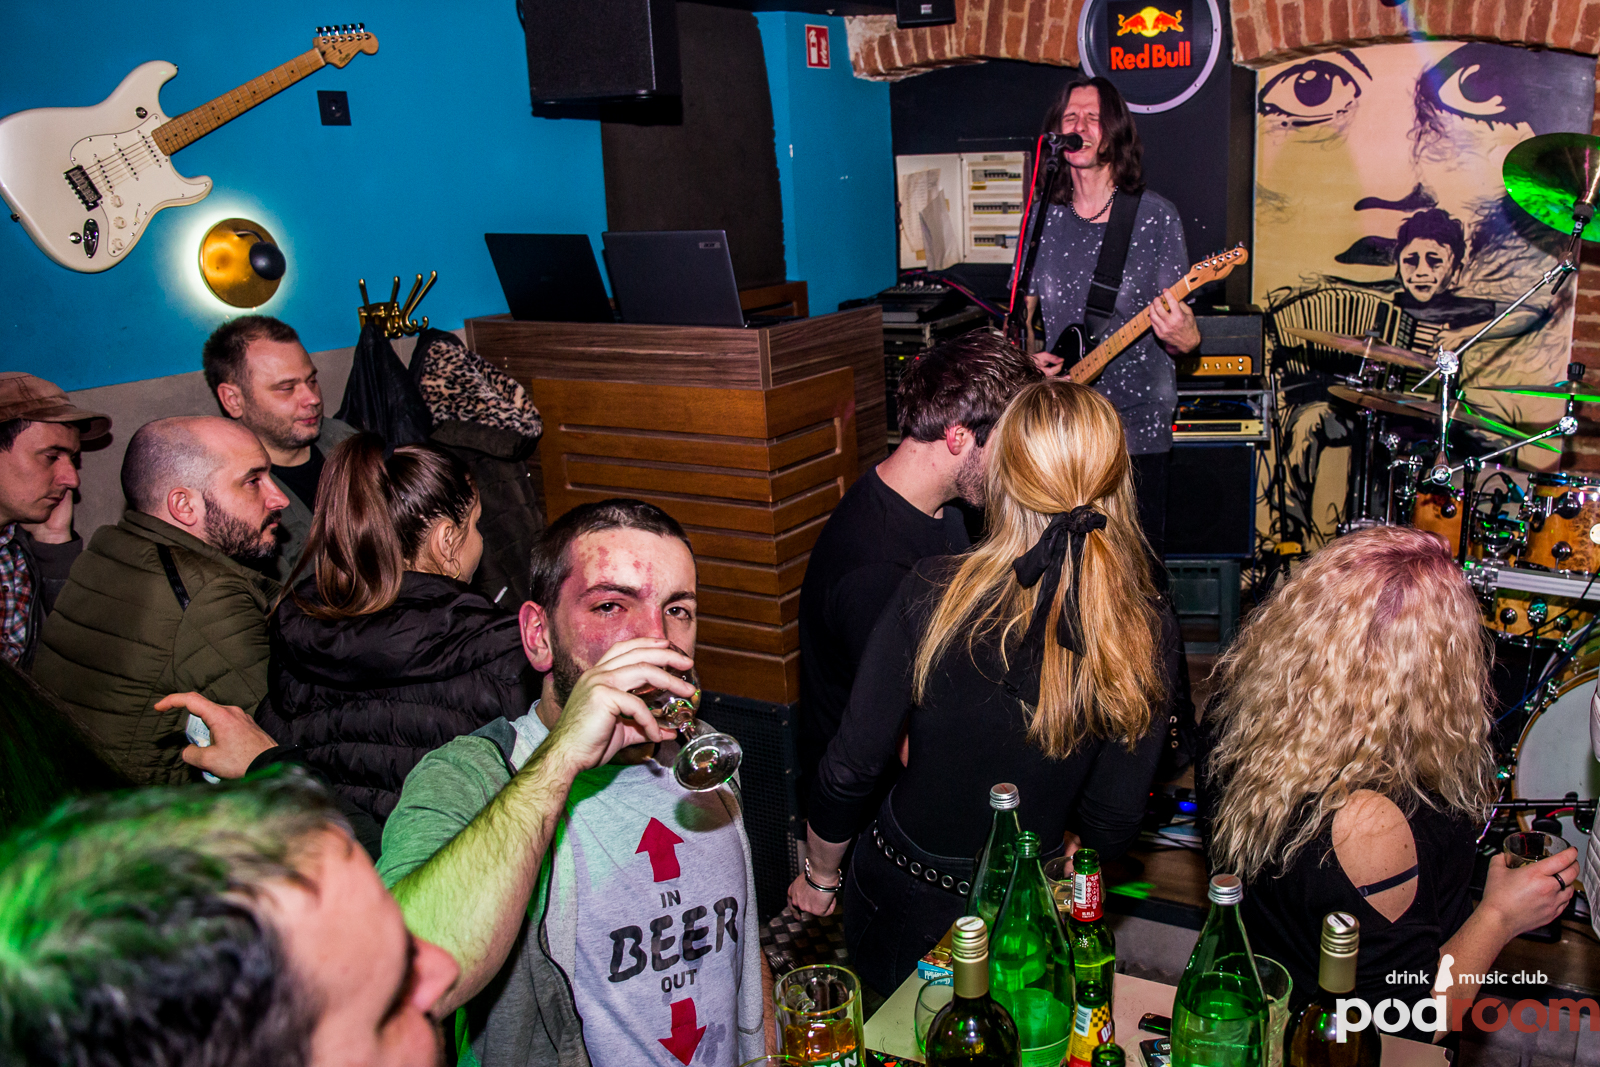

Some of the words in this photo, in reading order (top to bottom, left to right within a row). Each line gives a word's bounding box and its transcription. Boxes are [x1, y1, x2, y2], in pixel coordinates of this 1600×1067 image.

[1110, 43, 1150, 70] Red
[1152, 41, 1191, 68] Bull
[659, 889, 682, 909] IN
[607, 896, 739, 983] BEER
[661, 968, 698, 993] OUT
